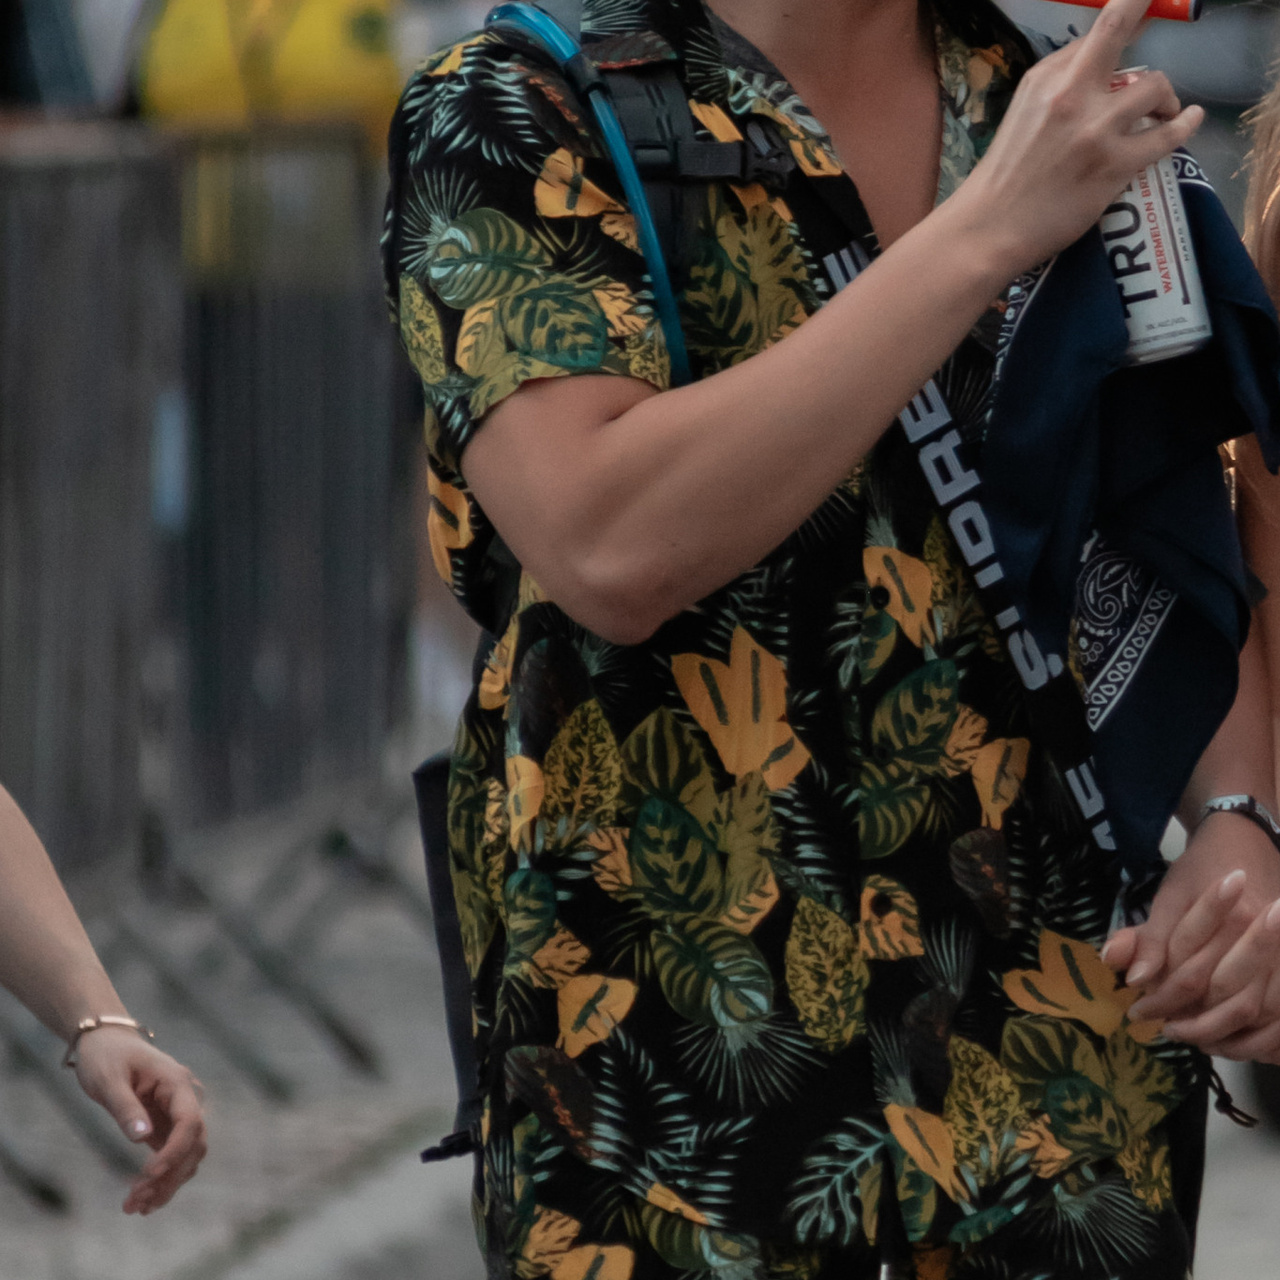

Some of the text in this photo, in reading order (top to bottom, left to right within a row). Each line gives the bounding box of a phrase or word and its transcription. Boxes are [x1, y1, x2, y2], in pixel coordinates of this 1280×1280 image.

[1101, 182, 1158, 319] TRU
[1138, 170, 1172, 294] WATERMELON BRE
[1175, 227, 1190, 262] HARD
